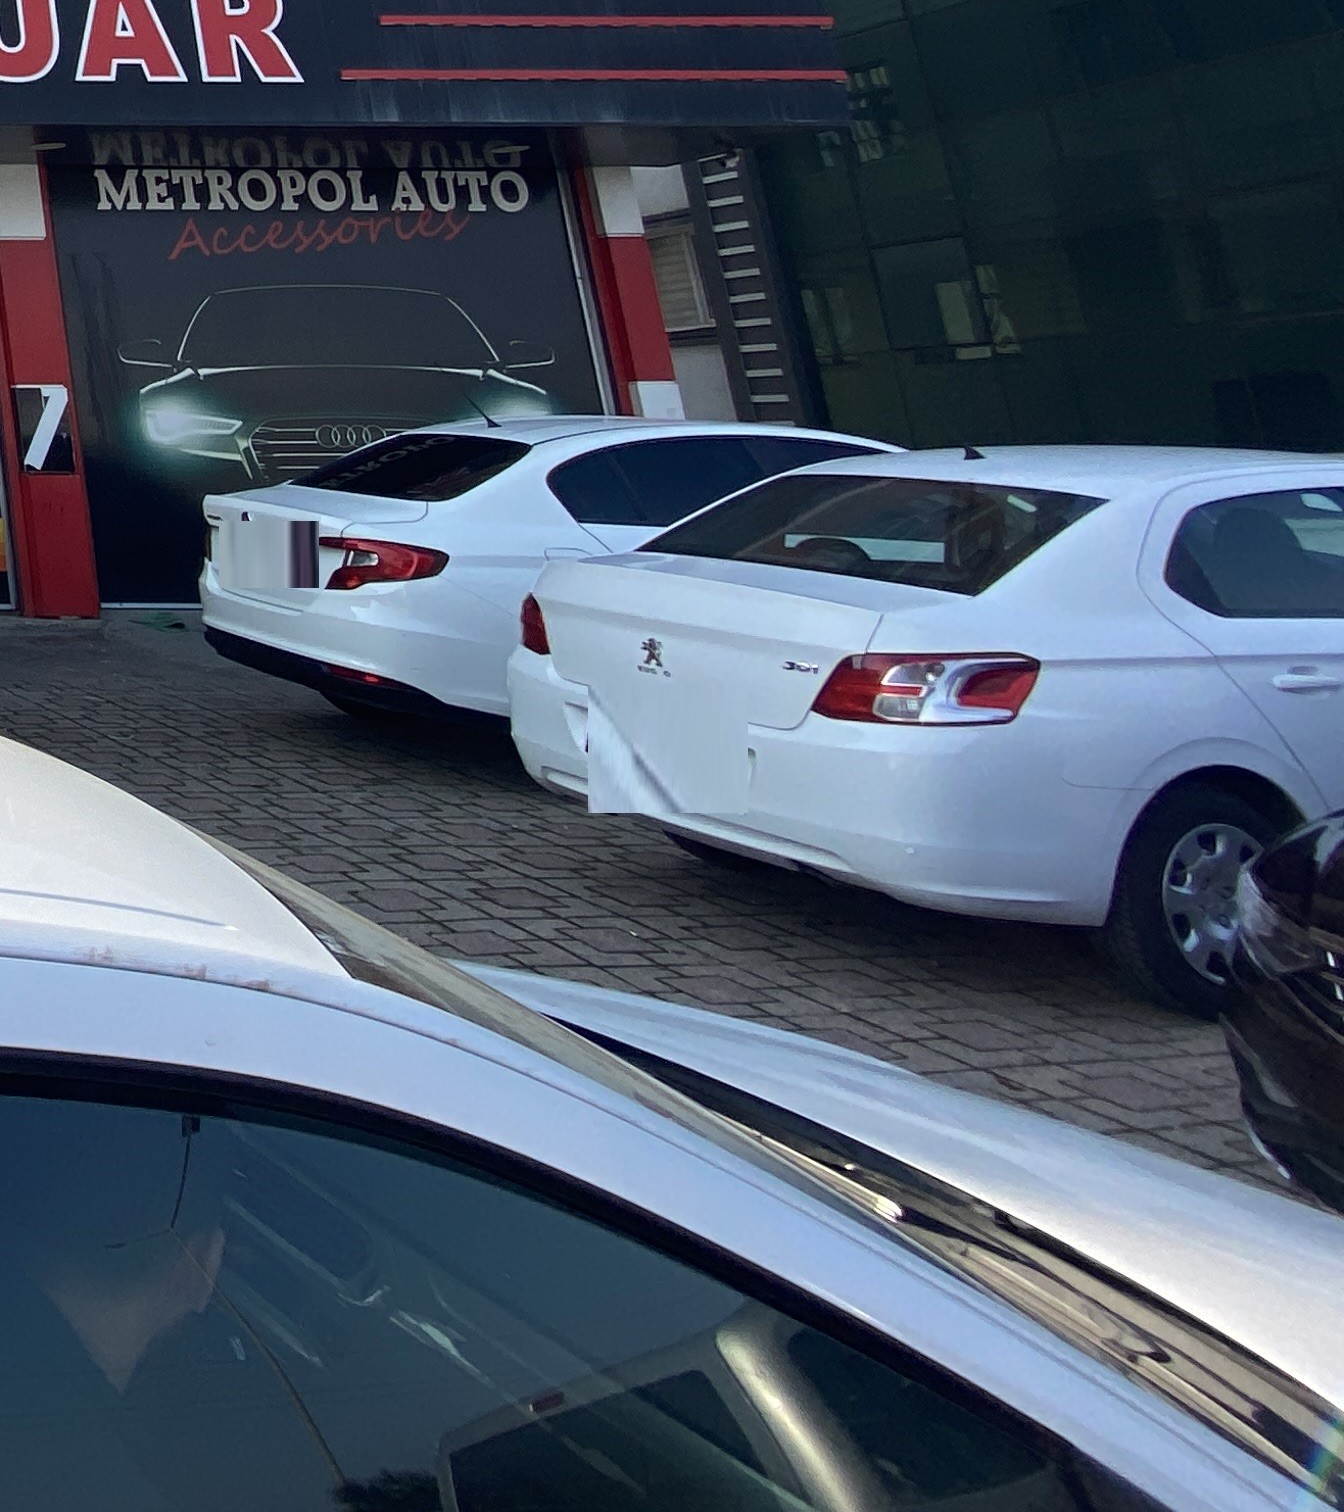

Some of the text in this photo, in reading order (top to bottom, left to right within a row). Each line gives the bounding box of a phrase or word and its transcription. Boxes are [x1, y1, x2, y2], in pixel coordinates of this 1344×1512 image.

[94, 169, 529, 213] METROPOL AUTO
[168, 206, 470, 261] Accessories
